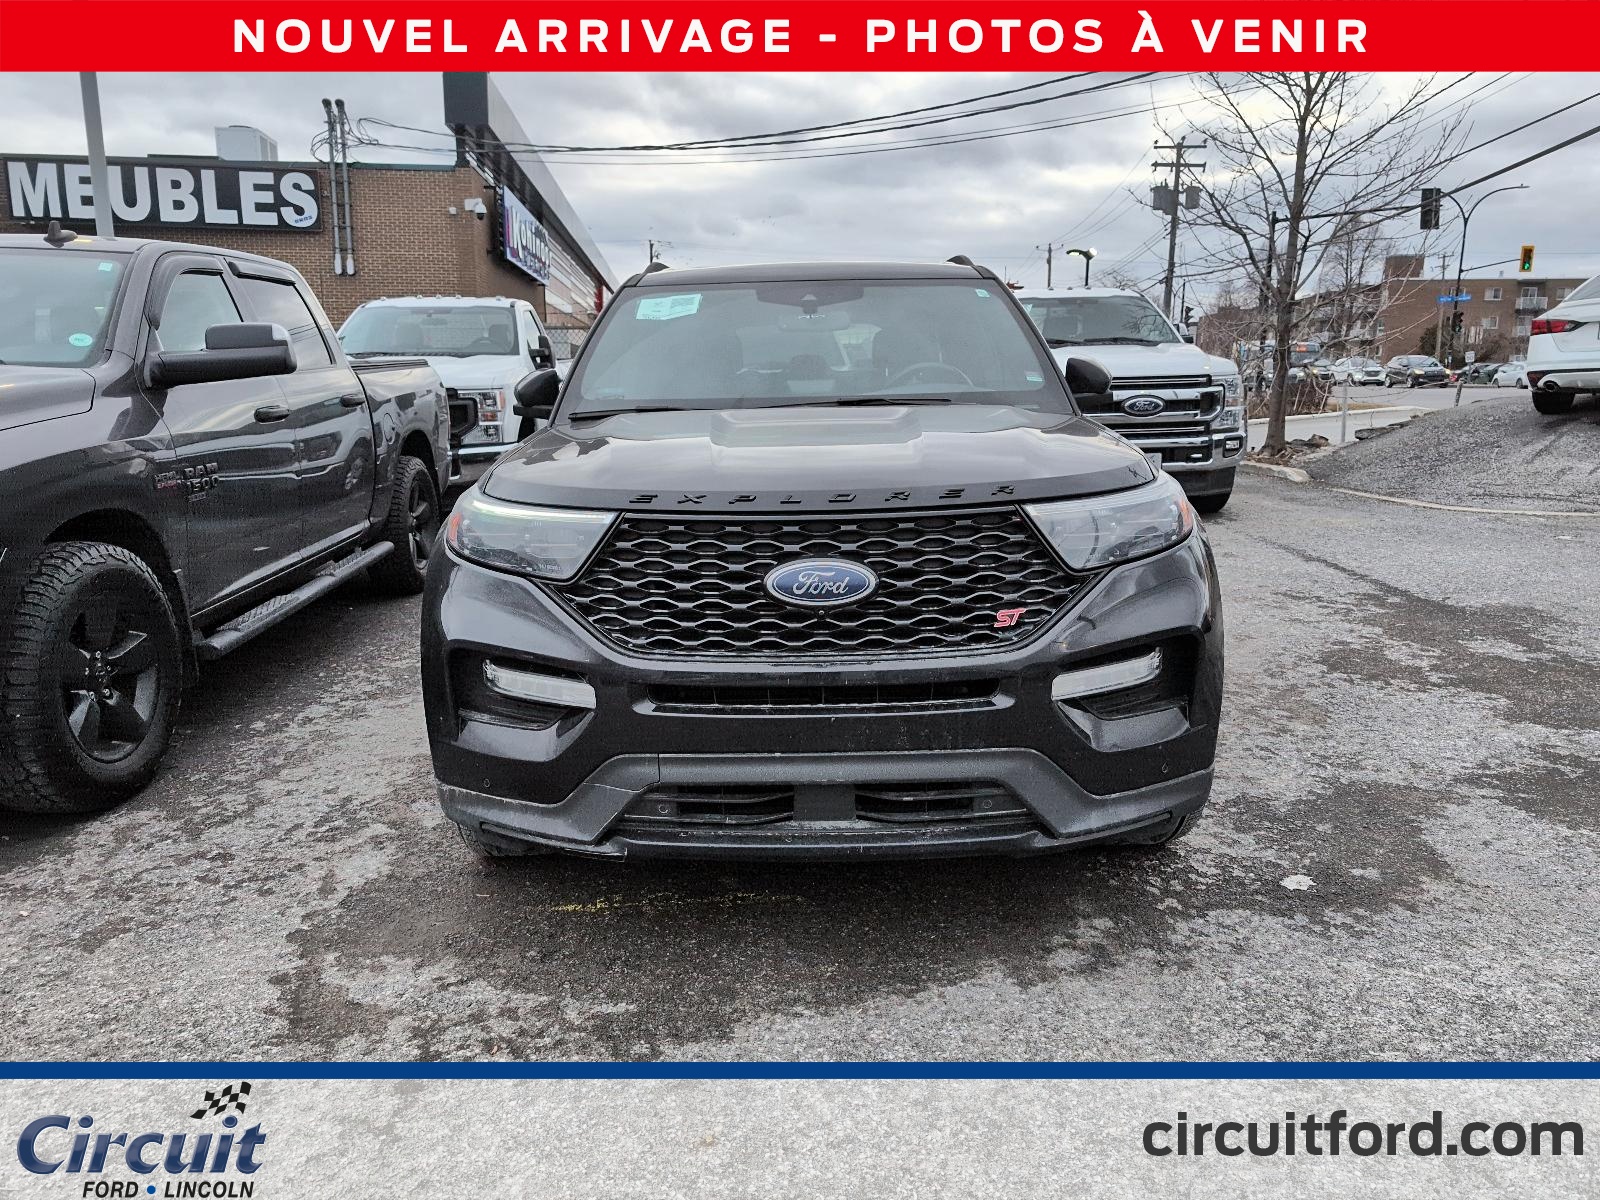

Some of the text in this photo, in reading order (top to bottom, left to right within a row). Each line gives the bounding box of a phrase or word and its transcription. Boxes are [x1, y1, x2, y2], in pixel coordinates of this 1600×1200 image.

[7, 161, 318, 228] MEUBLES
[184, 462, 218, 479] RAM
[629, 484, 1015, 504] EXPLORER
[792, 570, 850, 595] Ford
[994, 607, 1027, 628] ST
